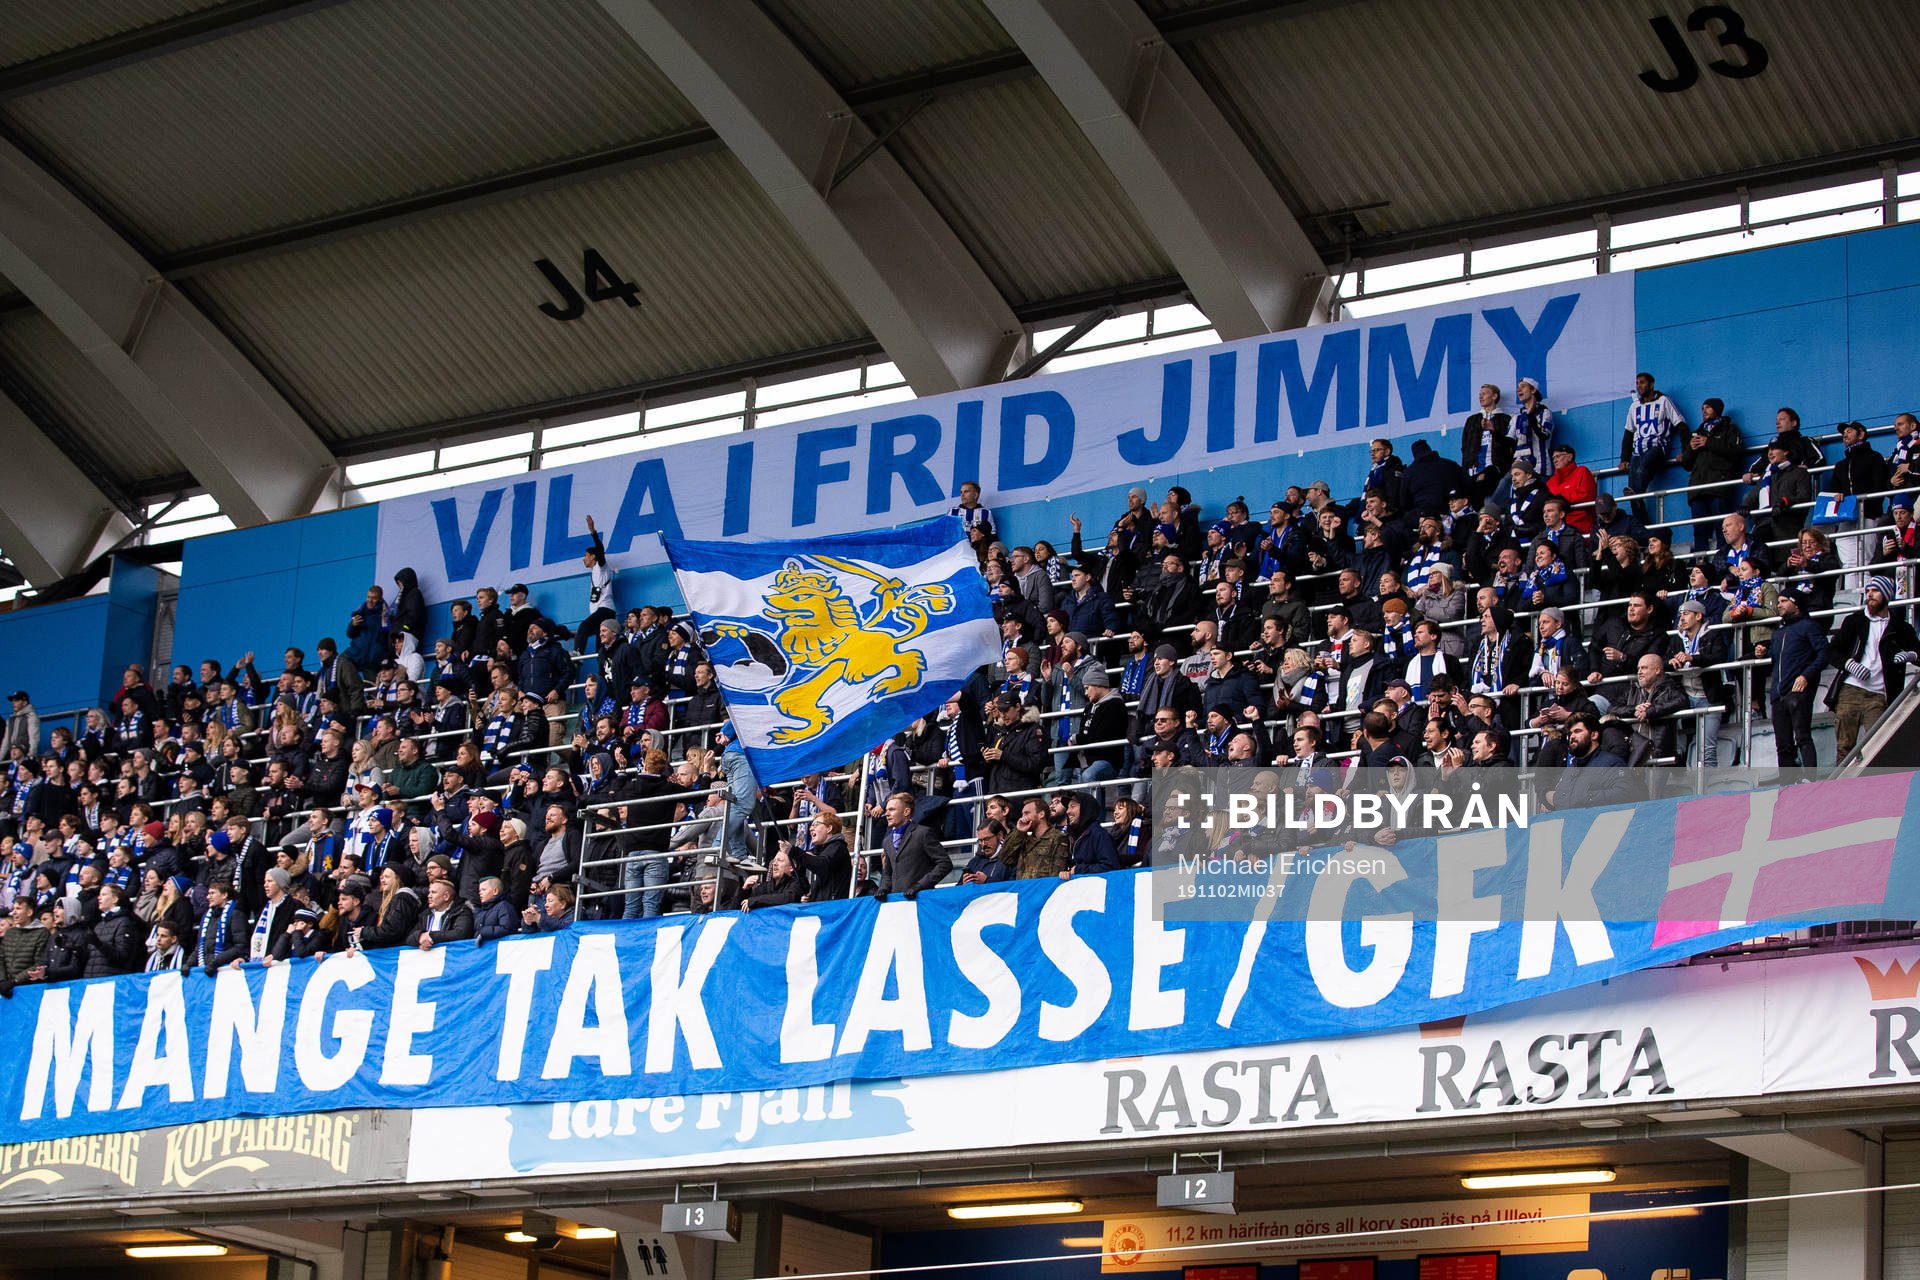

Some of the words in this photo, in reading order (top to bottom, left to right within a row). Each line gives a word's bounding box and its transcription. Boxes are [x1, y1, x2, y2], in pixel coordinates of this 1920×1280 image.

[1638, 5, 1769, 93] J3
[533, 247, 641, 321] J4
[431, 459, 686, 583] VILA
[722, 441, 754, 537] I
[791, 390, 1075, 528] FRID
[1117, 293, 1581, 466] JIMMY
[20, 946, 446, 1121] MANGE
[496, 916, 739, 1082] TAK
[1100, 1055, 1339, 1134] RASTA
[1417, 1027, 1676, 1114] RASTA
[161, 1113, 353, 1188] KOPPARBERG
[1184, 1178, 1207, 1200] 12
[685, 1207, 705, 1226] 13
[1167, 1225, 1196, 1244] 11,2
[1200, 1224, 1223, 1241] km
[1229, 1221, 1290, 1239] härifrån
[1294, 1218, 1330, 1238] görs
[1335, 1216, 1355, 1234] all
[1359, 1215, 1397, 1233] korv
[1400, 1212, 1436, 1231] som
[1440, 1211, 1466, 1229] äts
[1471, 1208, 1491, 1231] på
